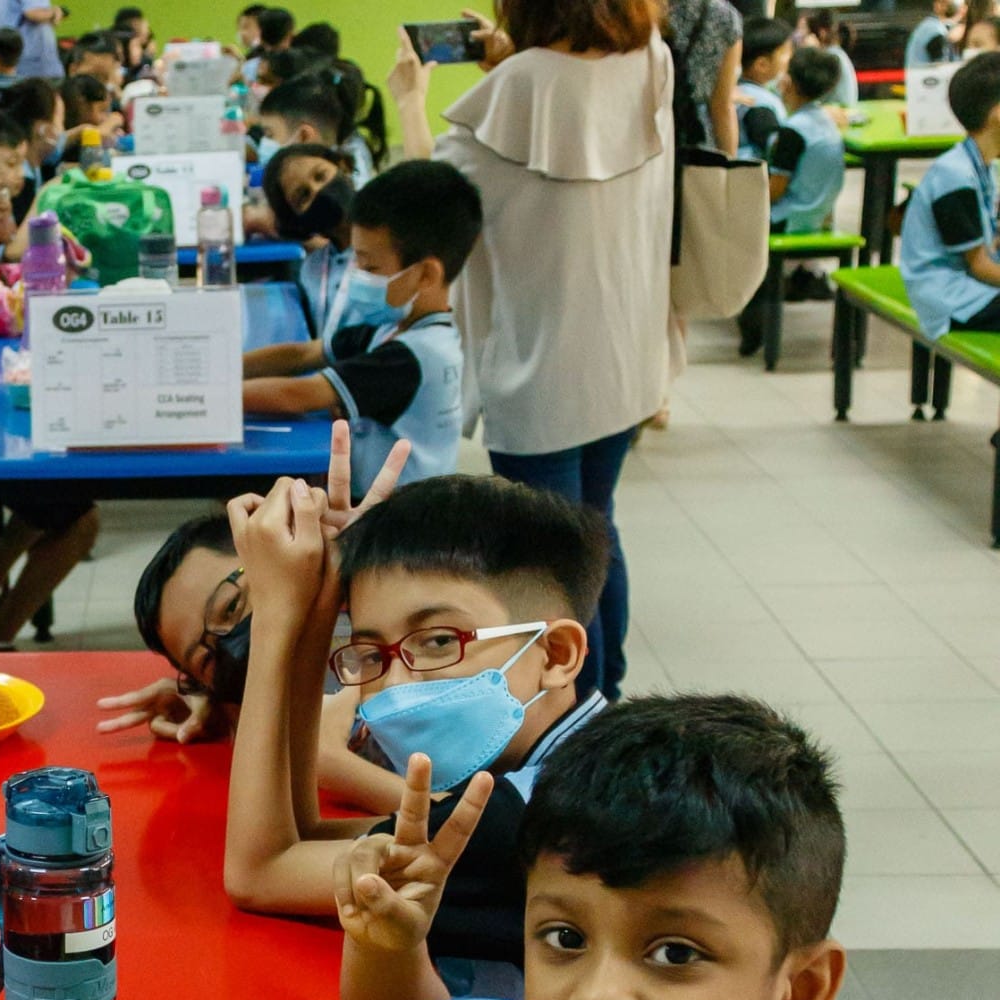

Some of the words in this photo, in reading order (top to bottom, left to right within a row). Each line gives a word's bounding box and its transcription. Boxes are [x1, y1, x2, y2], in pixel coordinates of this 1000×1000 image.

[60, 312, 87, 328] OG4
[102, 311, 139, 325] Table
[146, 310, 163, 324] 15
[155, 409, 207, 420] Arrangement
